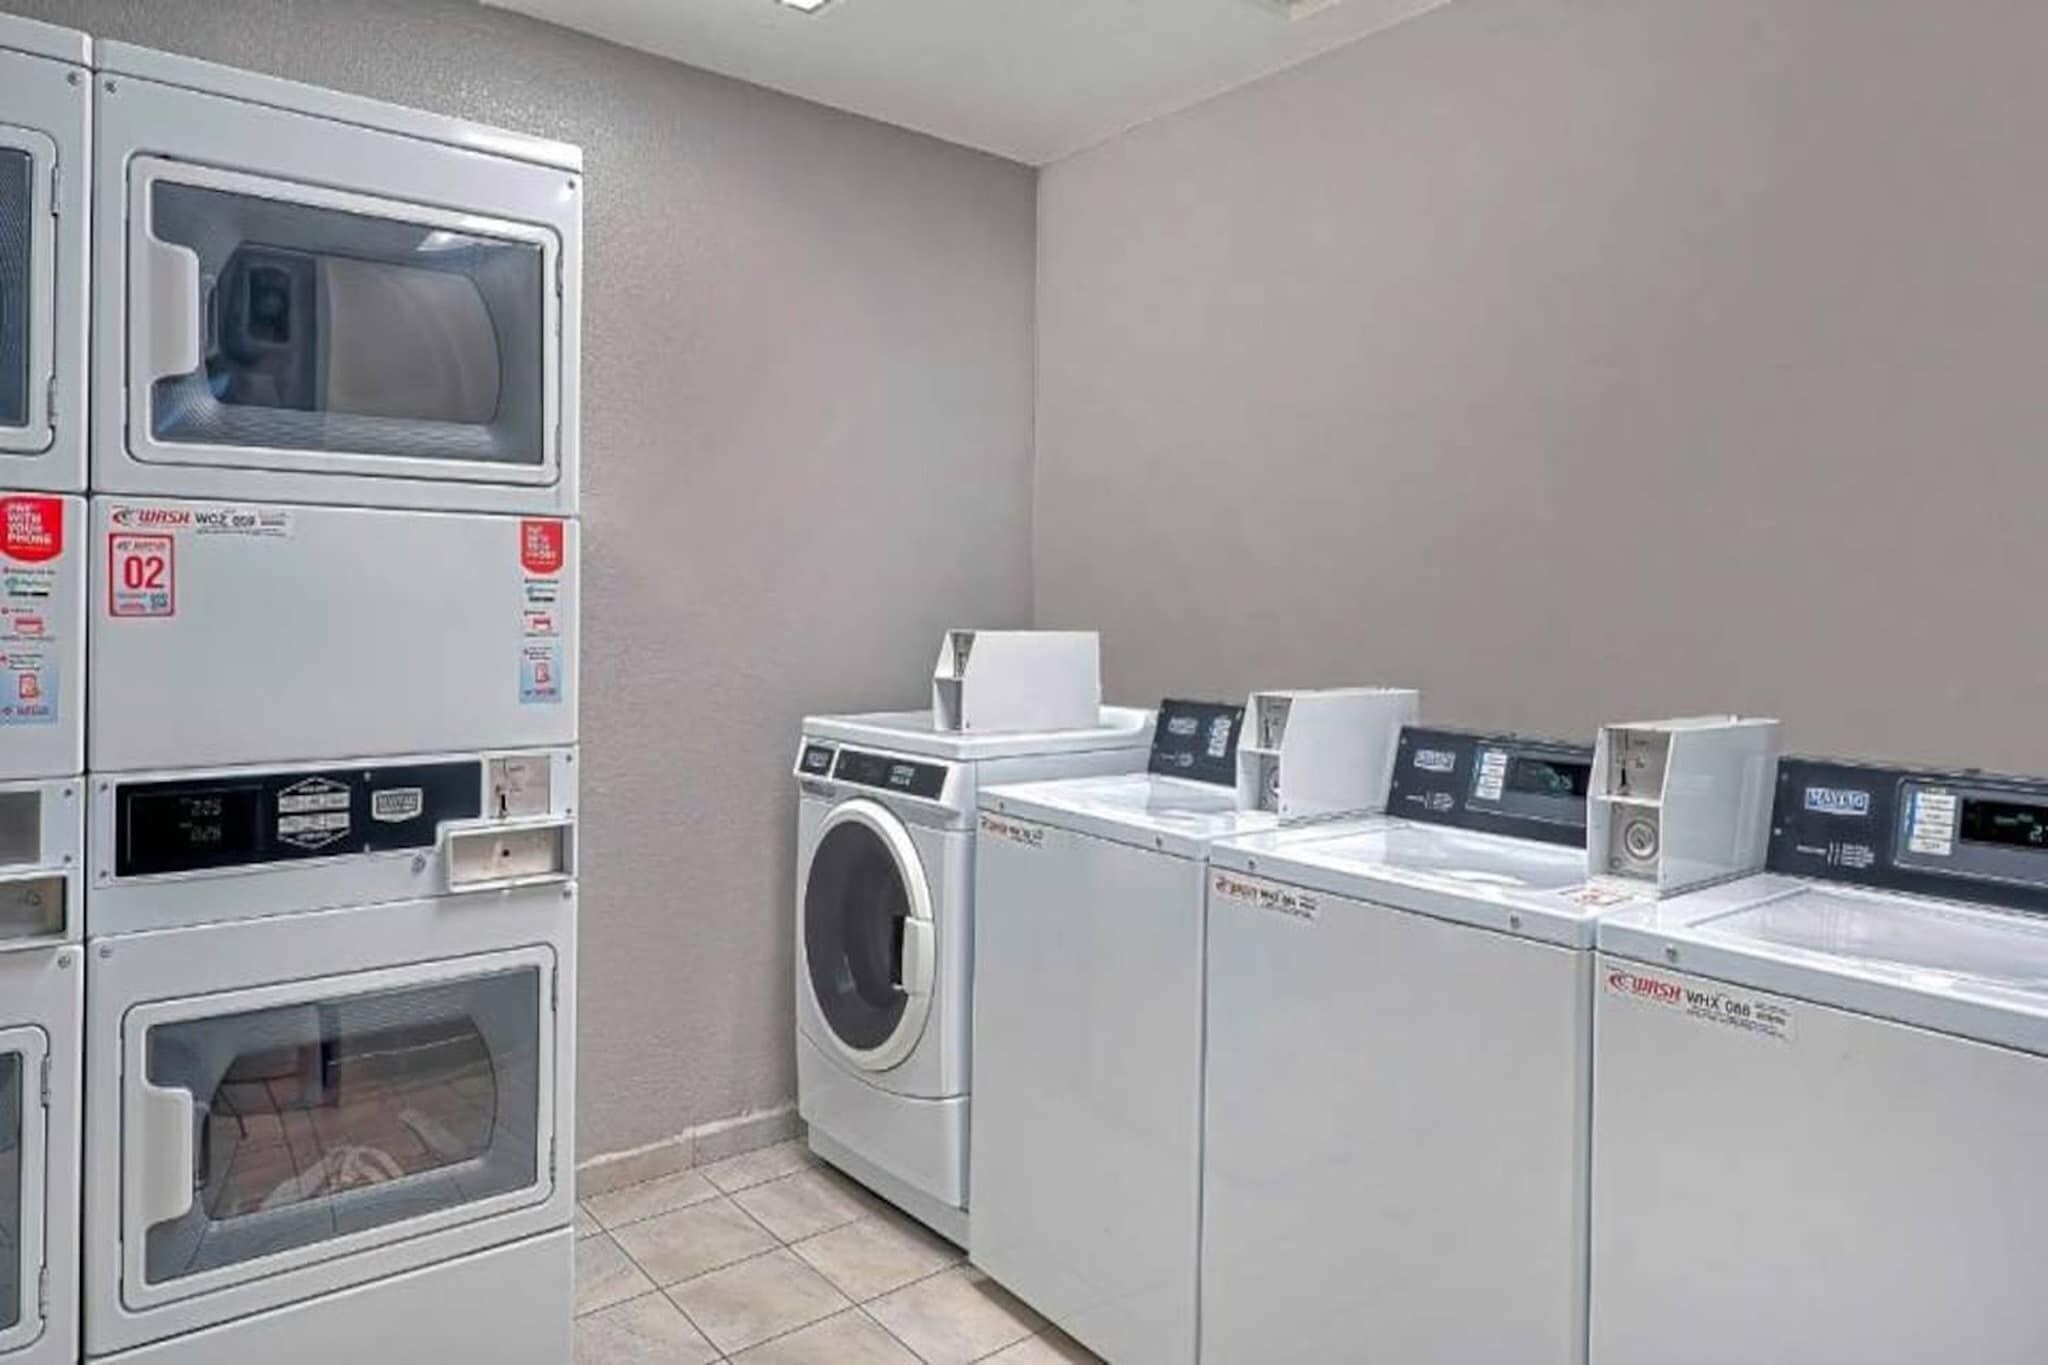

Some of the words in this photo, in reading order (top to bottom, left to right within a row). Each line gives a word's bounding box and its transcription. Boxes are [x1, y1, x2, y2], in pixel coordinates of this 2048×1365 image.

[137, 508, 191, 525] WASH
[125, 555, 165, 589] 02
[1631, 975, 1683, 1002] WASH
[1686, 989, 1720, 1009] WHX
